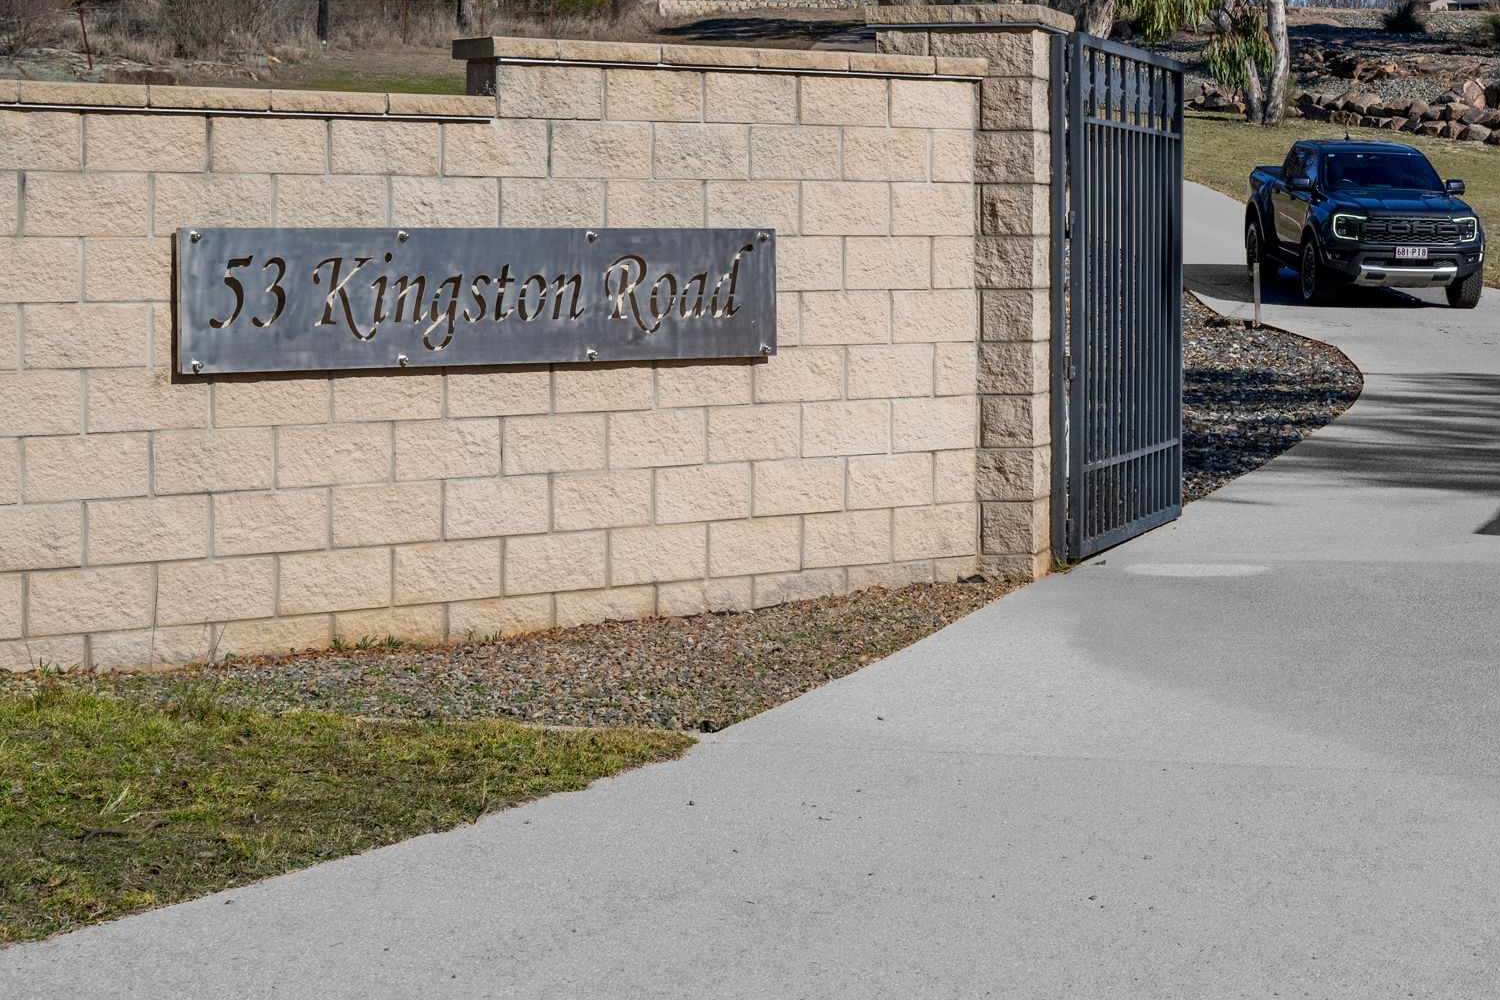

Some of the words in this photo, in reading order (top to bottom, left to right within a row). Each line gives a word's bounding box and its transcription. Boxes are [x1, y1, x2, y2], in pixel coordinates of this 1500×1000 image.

[1361, 222, 1461, 235] FORD
[209, 255, 287, 329] 53
[312, 252, 584, 352] Kingston
[604, 243, 754, 334] Road
